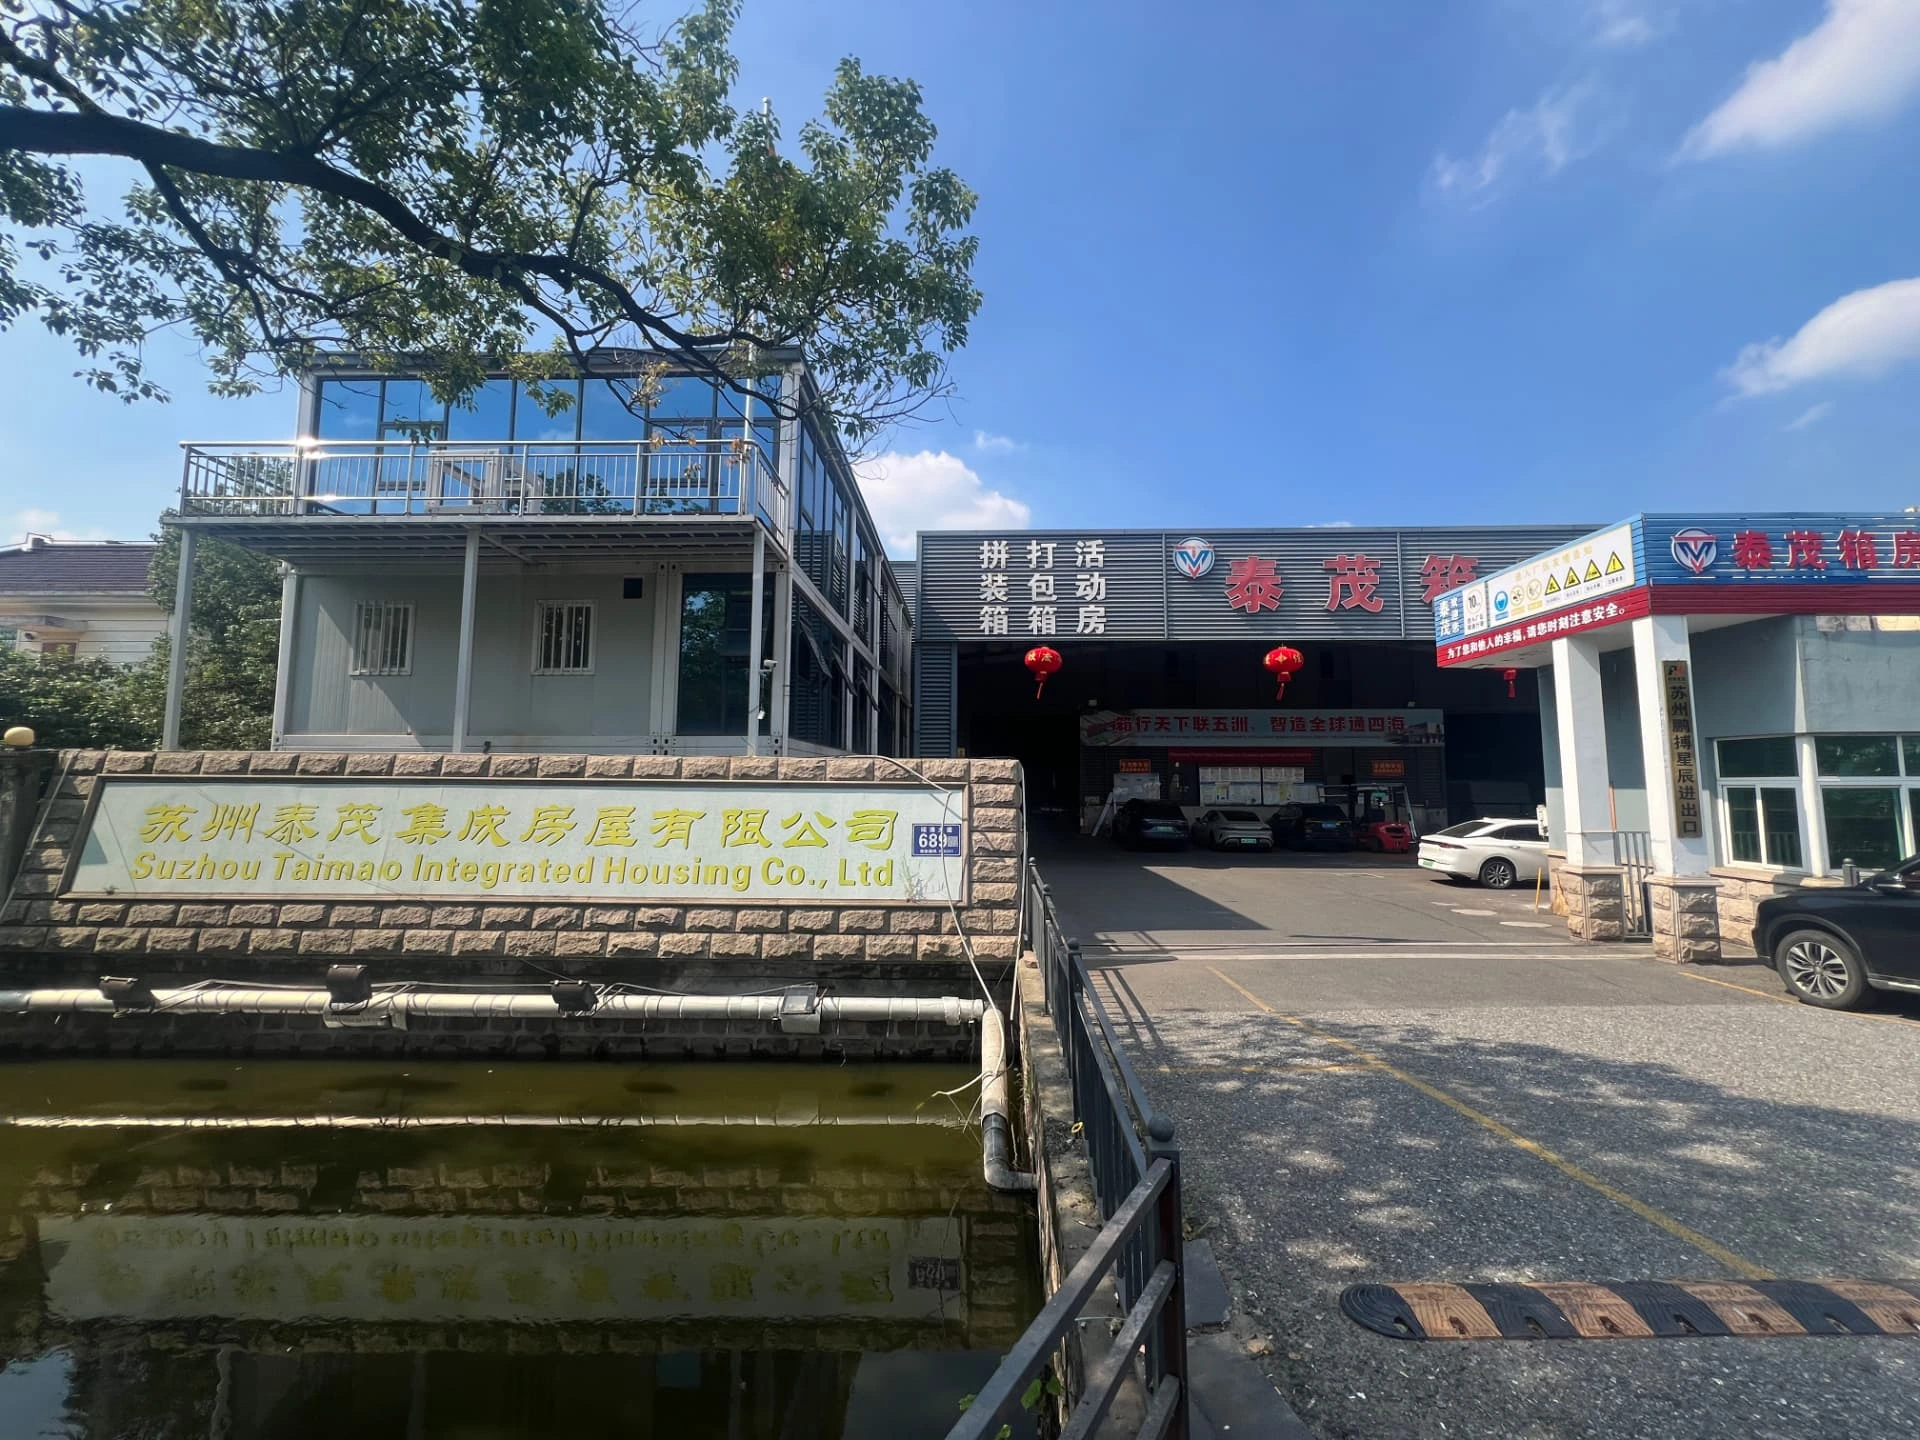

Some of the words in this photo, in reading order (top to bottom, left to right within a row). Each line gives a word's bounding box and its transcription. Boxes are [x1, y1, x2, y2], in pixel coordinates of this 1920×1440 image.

[979, 540, 1009, 635] 拼装箱
[1026, 540, 1058, 635] 打包箱
[1075, 539, 1107, 634] 活动房
[138, 801, 899, 851] 苏州泰茂集成房屋有限公司
[918, 832, 949, 849] 689
[132, 851, 262, 881] Suzhou
[272, 852, 402, 882] Taimao
[411, 853, 596, 890] Integrated
[602, 856, 752, 892] Housing
[760, 857, 830, 890] Co.,
[837, 858, 894, 887] Ltd
